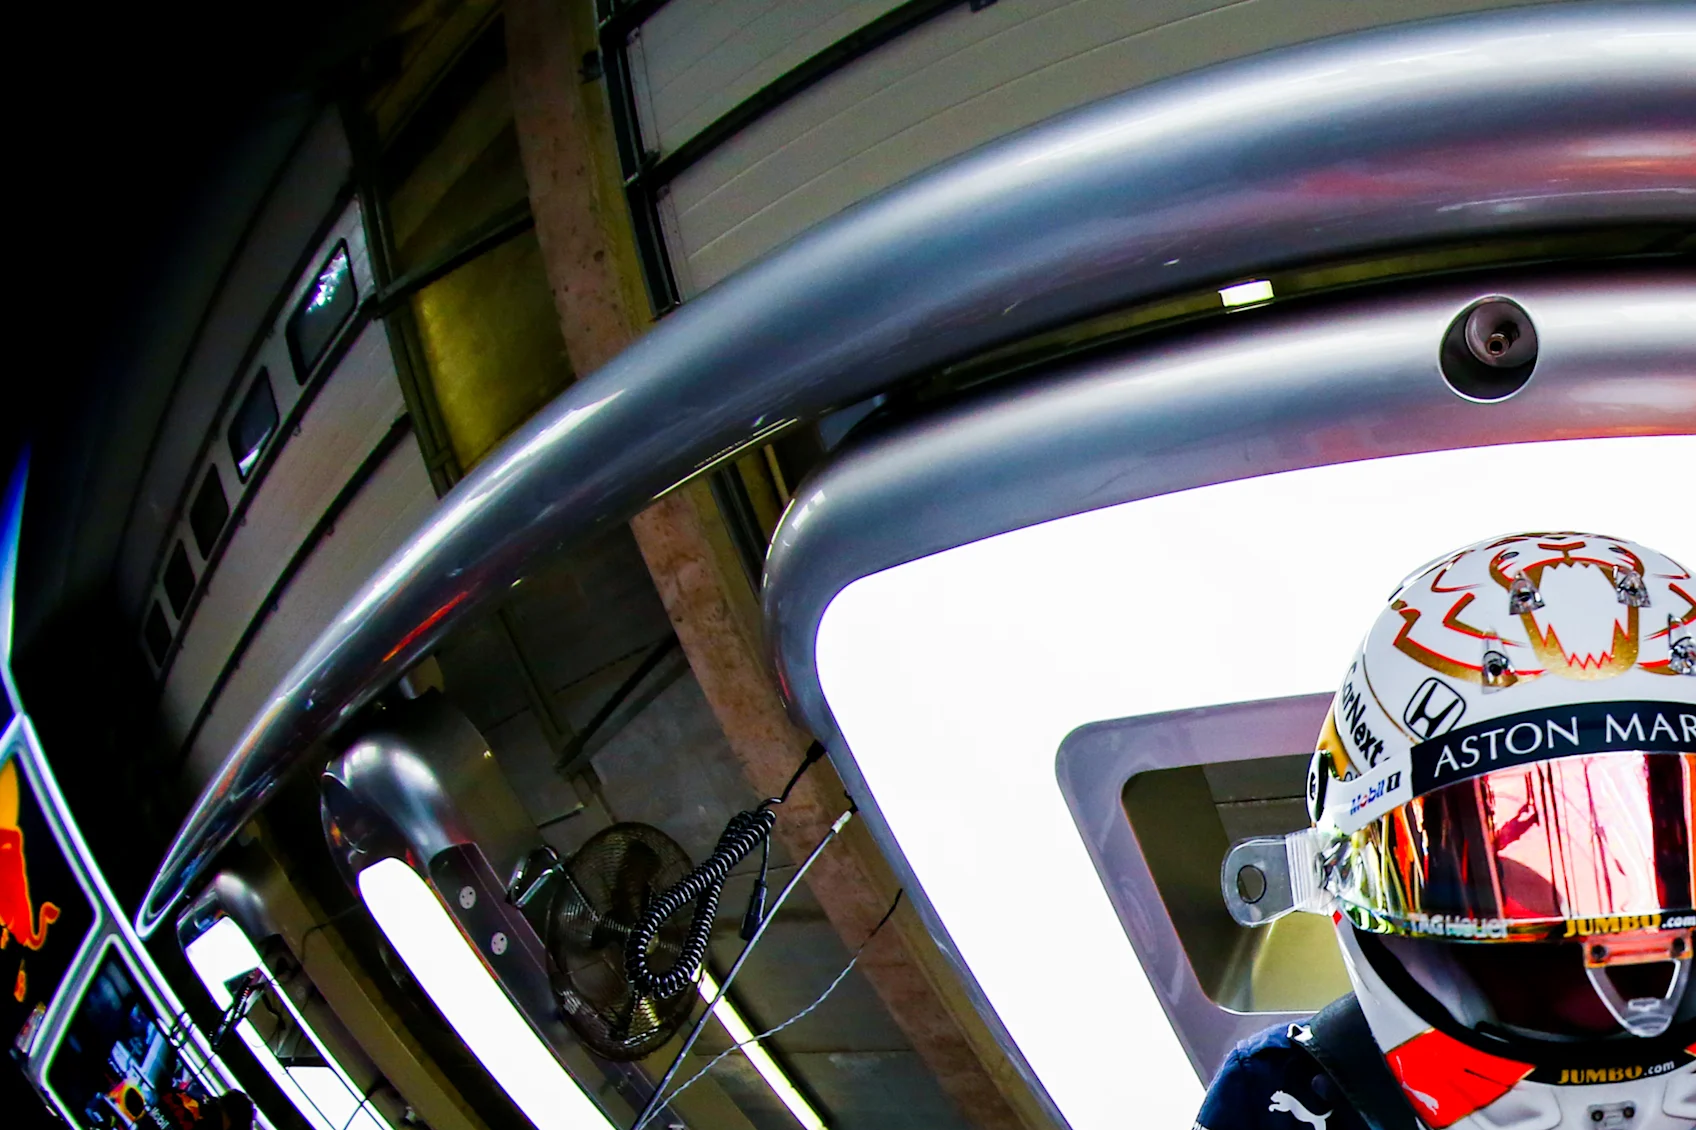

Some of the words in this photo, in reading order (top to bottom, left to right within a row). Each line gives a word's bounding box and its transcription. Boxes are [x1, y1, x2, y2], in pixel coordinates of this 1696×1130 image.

[1433, 716, 1580, 779] ASTON
[1350, 780, 1385, 815] Mobil
[1411, 914, 1444, 936] TAG
[1445, 917, 1509, 939] Heuer
